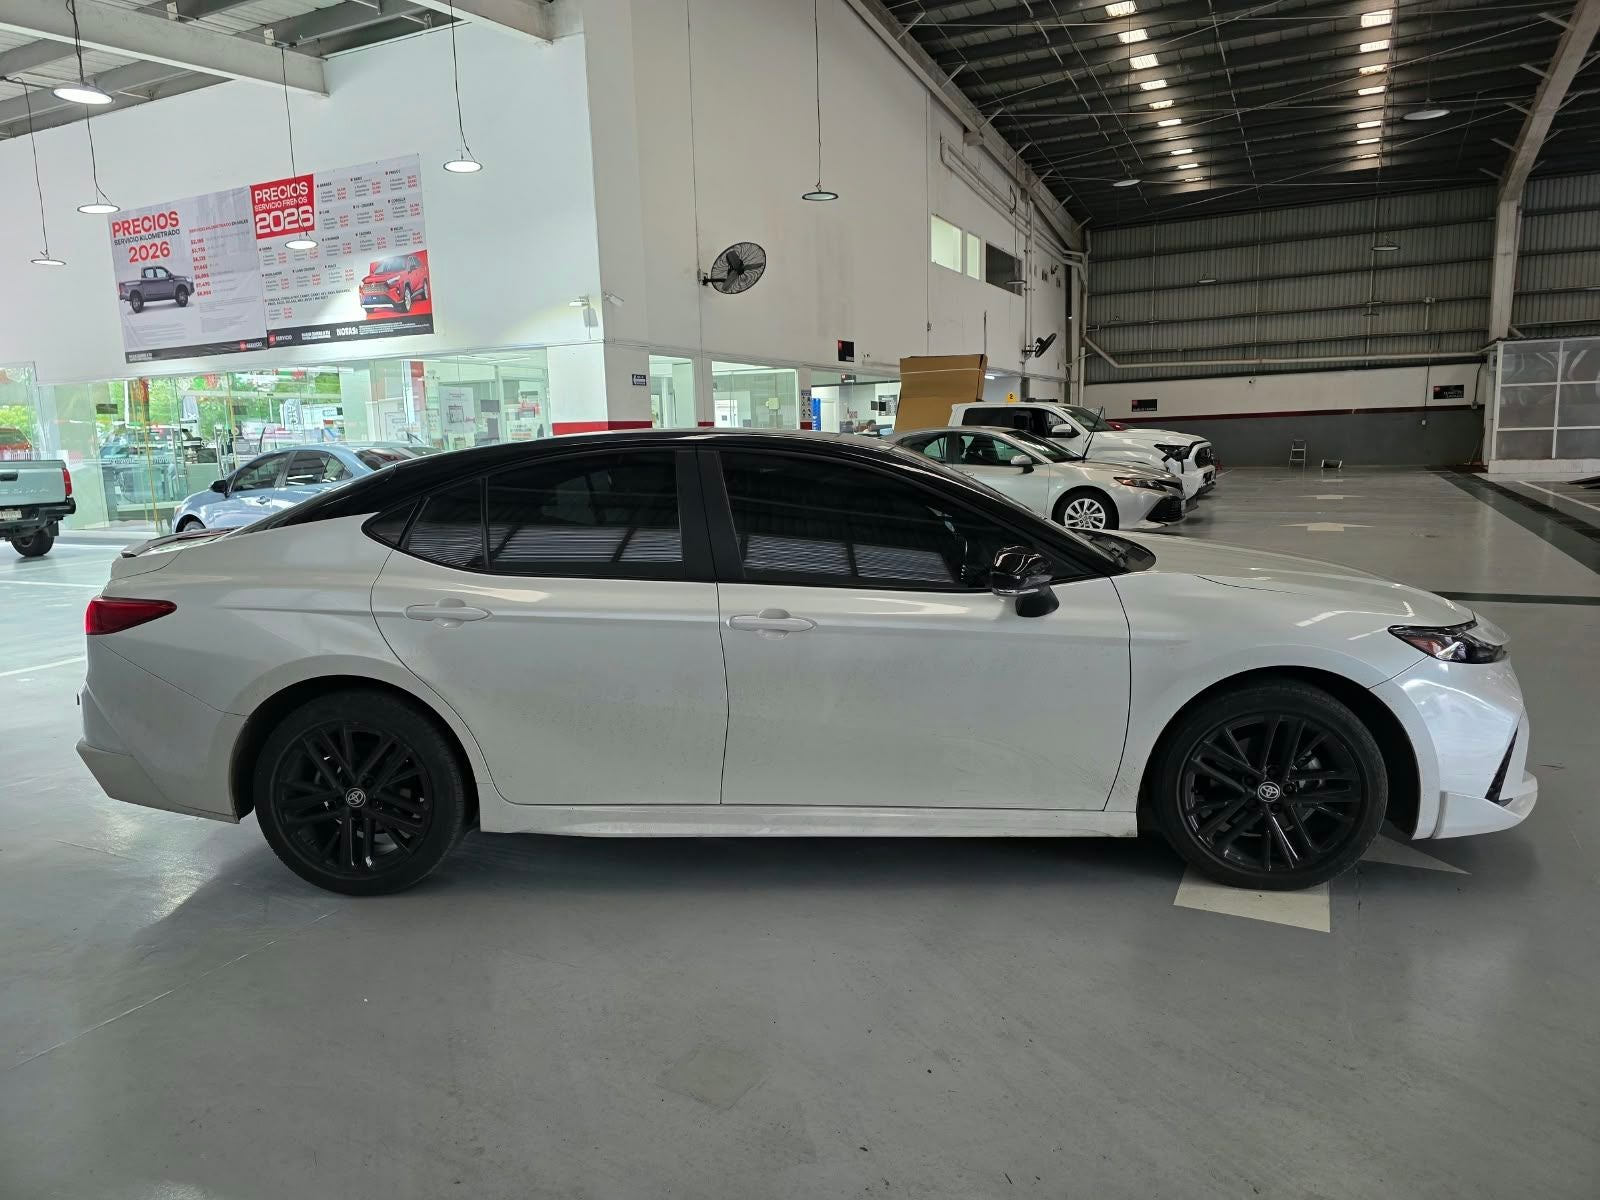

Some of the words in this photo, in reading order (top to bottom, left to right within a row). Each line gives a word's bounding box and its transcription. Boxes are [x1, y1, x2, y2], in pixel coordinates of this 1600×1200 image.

[254, 200, 282, 212] SERVICIO
[282, 196, 308, 207] FRENOS
[255, 182, 309, 204] PRECIOS
[112, 211, 179, 238] PRECIOS
[255, 205, 314, 235] 2026
[114, 236, 139, 246] SERVICIO
[140, 229, 180, 241] KILOMETRADO
[129, 241, 170, 263] 2026
